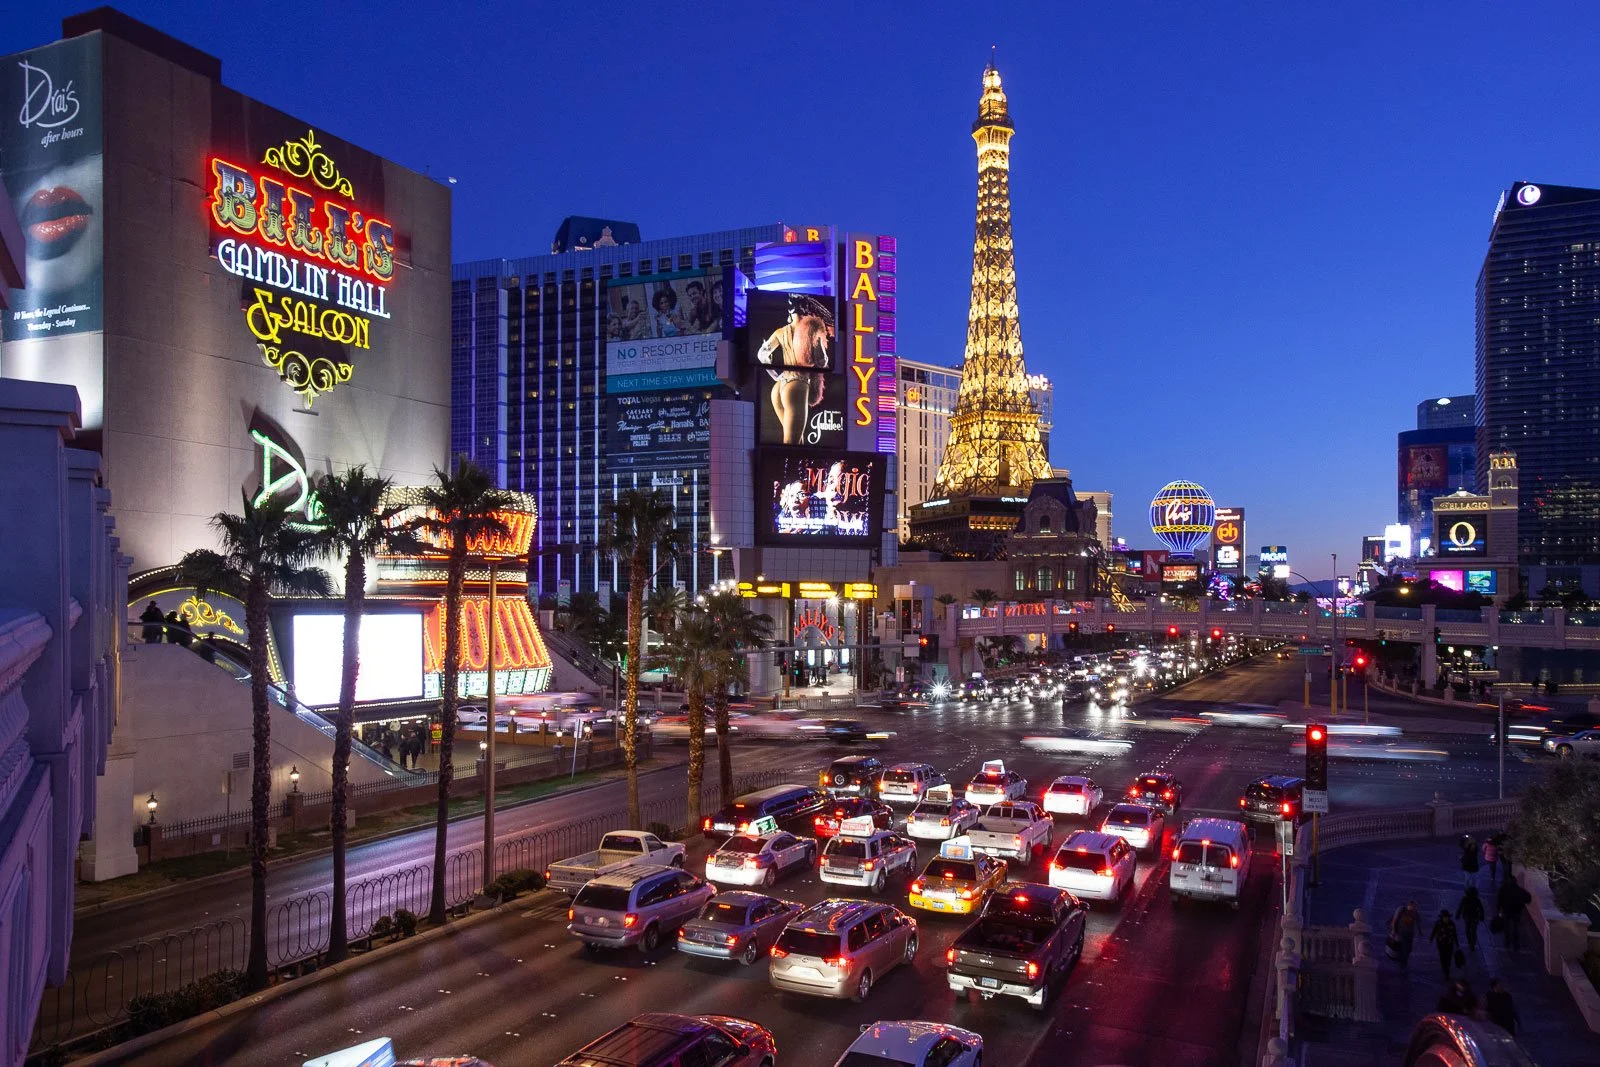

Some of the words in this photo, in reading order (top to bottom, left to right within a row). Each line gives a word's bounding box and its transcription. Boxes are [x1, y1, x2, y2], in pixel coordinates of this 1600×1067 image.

[18, 60, 80, 128] Drai's
[41, 130, 60, 148] after
[61, 127, 84, 141] hours
[212, 158, 394, 281] BILL'S
[217, 238, 336, 300] GAMBLIN'
[337, 272, 391, 319] HALL
[43, 304, 61, 318] Legend
[55, 318, 76, 328] Sunday
[280, 296, 371, 350] SALOON
[851, 240, 877, 426] BALLYS
[617, 347, 637, 360] NO
[641, 342, 690, 359] RESORT
[617, 380, 638, 389] NEXT
[642, 378, 660, 387] TIME
[662, 376, 684, 385] STAY
[686, 374, 709, 383] WITH
[617, 396, 641, 405] TOTAL
[808, 411, 844, 445] Jubilee!
[804, 467, 870, 502] Mgic
[1440, 501, 1489, 510] BELLAGIO
[1449, 521, 1477, 547] O
[1260, 552, 1287, 561] MGM
